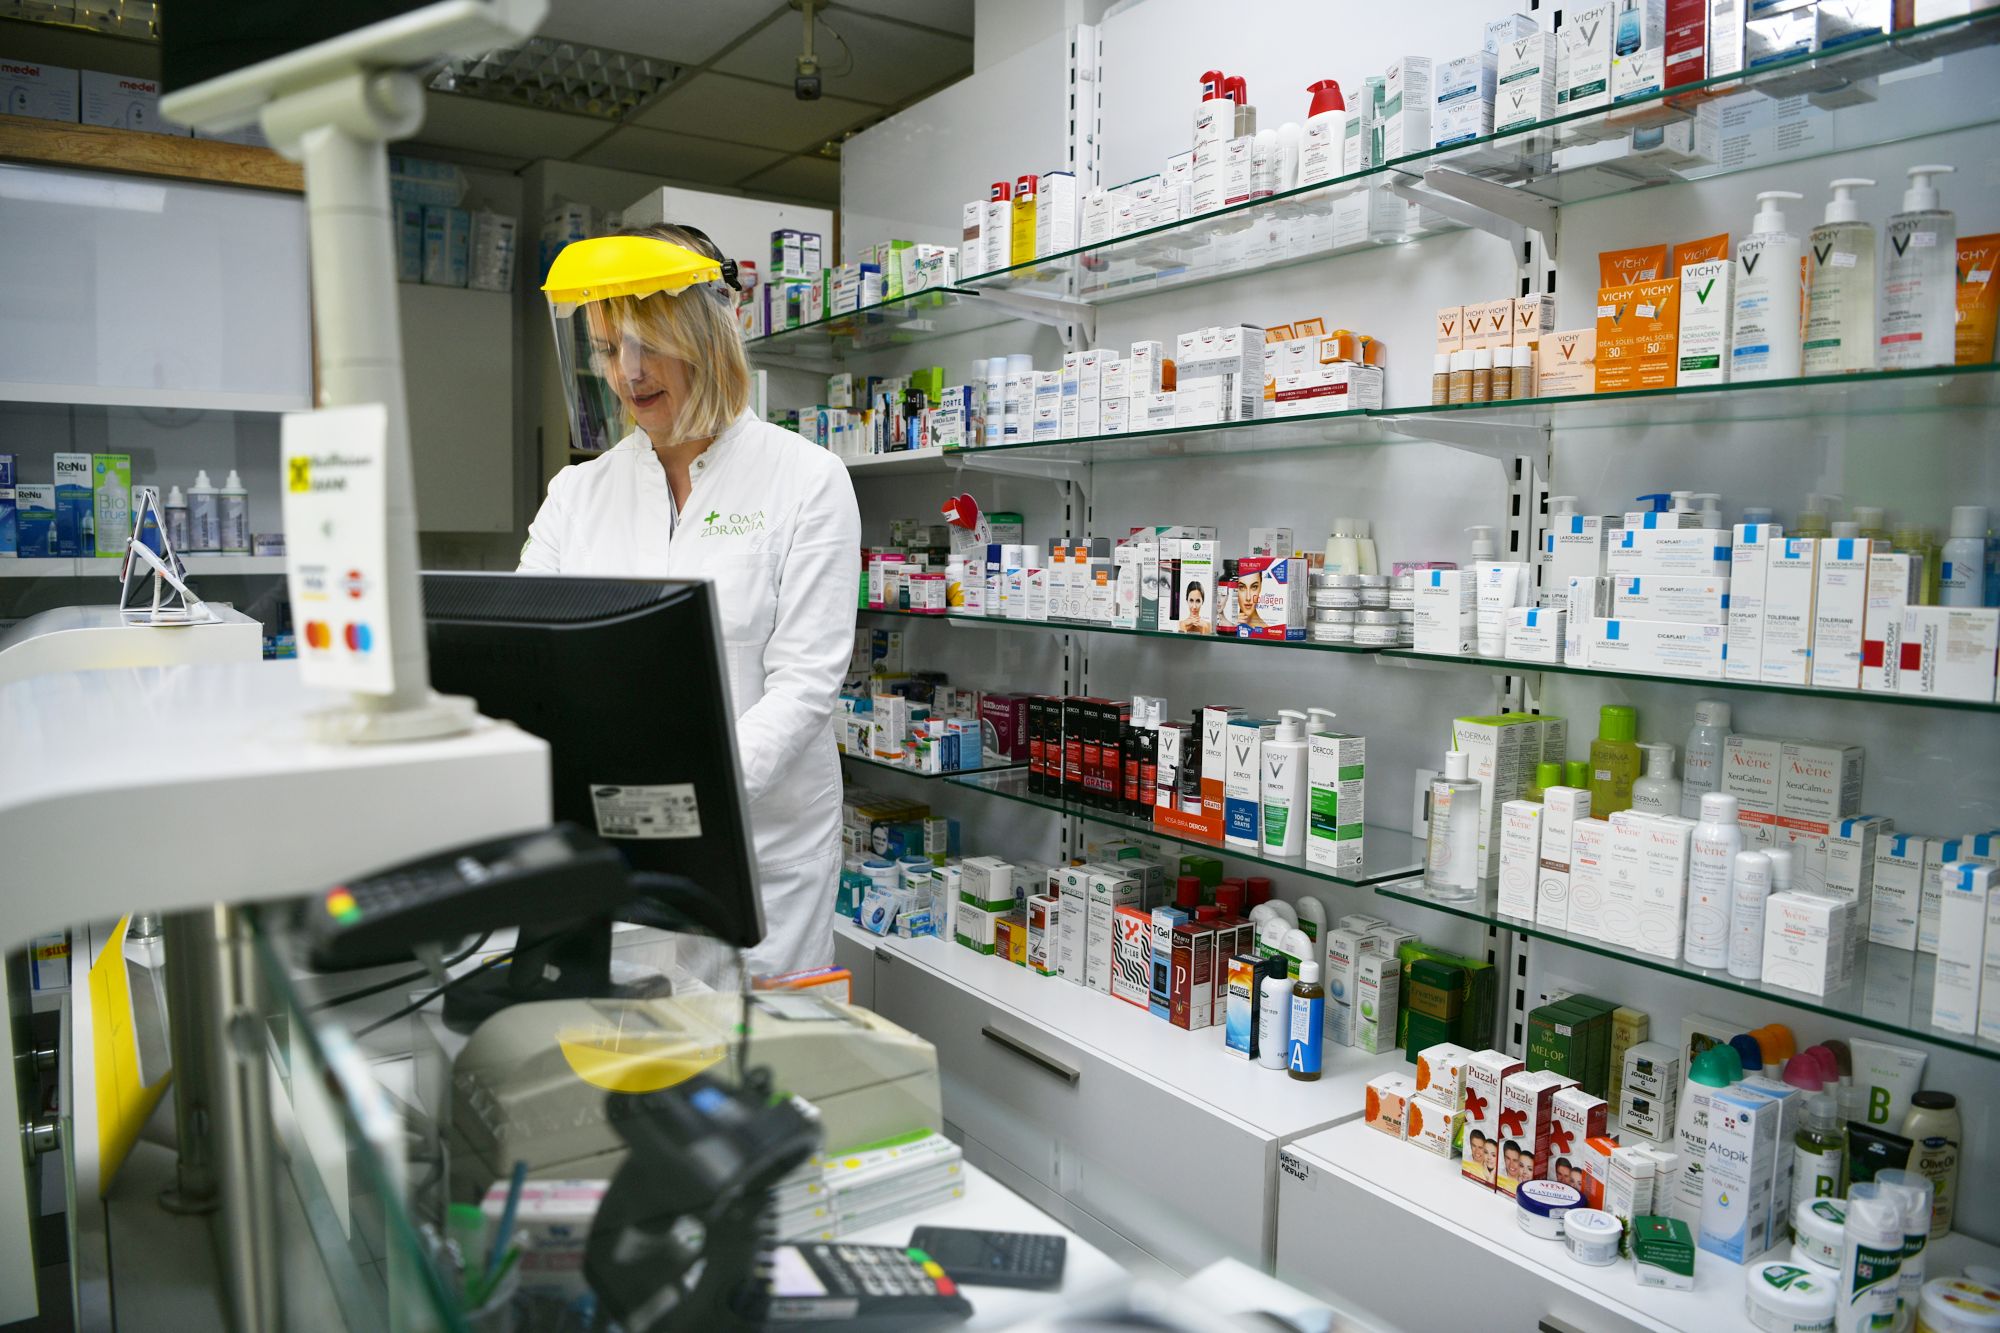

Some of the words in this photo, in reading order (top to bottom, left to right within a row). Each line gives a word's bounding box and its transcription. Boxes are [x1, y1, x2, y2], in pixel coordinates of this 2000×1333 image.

[1574, 7, 1606, 24] VICHY
[1489, 21, 1512, 32] VICHY
[1512, 38, 1528, 48] VICHY
[2, 64, 40, 77] medel
[120, 80, 156, 93] medel
[1509, 87, 1526, 96] VICHY
[1196, 114, 1213, 128] Eucerin
[1810, 230, 1840, 241] VICHY
[1739, 241, 1766, 252] VICHY
[1684, 246, 1712, 261] VICHY
[1957, 248, 1989, 260] ICHY
[1614, 256, 1648, 270] VICHY
[1686, 264, 1722, 278] VICHY
[1641, 284, 1674, 296] VICHY
[1602, 290, 1634, 302] VICHY
[1465, 310, 1485, 318] VICHY
[1488, 306, 1508, 314] VICHY
[1438, 312, 1458, 320] VICHY
[1557, 334, 1580, 342] VICHY
[1616, 338, 1634, 346] SOLEIL
[1654, 333, 1674, 342] SOLEIL
[1608, 347, 1620, 358] 30
[1647, 343, 1660, 354] 50
[943, 398, 962, 408] FORTE
[56, 462, 87, 472] ReNu
[18, 490, 42, 499] ReNu
[99, 494, 126, 510] Bio
[100, 510, 127, 520] true
[1252, 594, 1284, 606] Collagen
[1102, 712, 1117, 720] DERCOS
[1206, 720, 1224, 728] VICHY
[1232, 734, 1254, 744] VICHY
[1457, 730, 1492, 741] A-DERMA
[1206, 749, 1222, 757] DERCOS
[1266, 752, 1288, 760] VICHY
[1312, 746, 1334, 756] DERCOS
[1732, 752, 1770, 770] Avène
[1234, 771, 1251, 779] DERCOS
[1792, 761, 1832, 778] Avène
[1728, 772, 1762, 784] XeraCalm
[1086, 777, 1112, 791] GRATIS
[1786, 780, 1822, 793] XeraCalm
[1204, 800, 1220, 810] GRATIS
[1234, 814, 1244, 822] 100
[1188, 820, 1208, 832] DERCOS
[1234, 820, 1250, 828] GRATIS
[1508, 818, 1532, 830] Avène
[1616, 825, 1640, 836] Avène
[1651, 833, 1678, 846] Avène
[1826, 883, 1854, 892] TOLERIANE
[1875, 884, 1906, 895] TOLERIANE
[1784, 909, 1809, 921] Avène
[1329, 948, 1349, 960] NERILEX
[1360, 975, 1378, 985] NERILEX
[1230, 984, 1250, 996] MYCOSEB
[1468, 1065, 1498, 1086] Puzzle
[1631, 1070, 1658, 1084] JOMELOP
[1504, 1085, 1534, 1106] Puzzle
[1868, 1086, 1891, 1124] B
[1552, 1105, 1584, 1126] Puzzle
[1627, 1110, 1654, 1122] JOMELOP
[1708, 1142, 1748, 1164] Atopik
